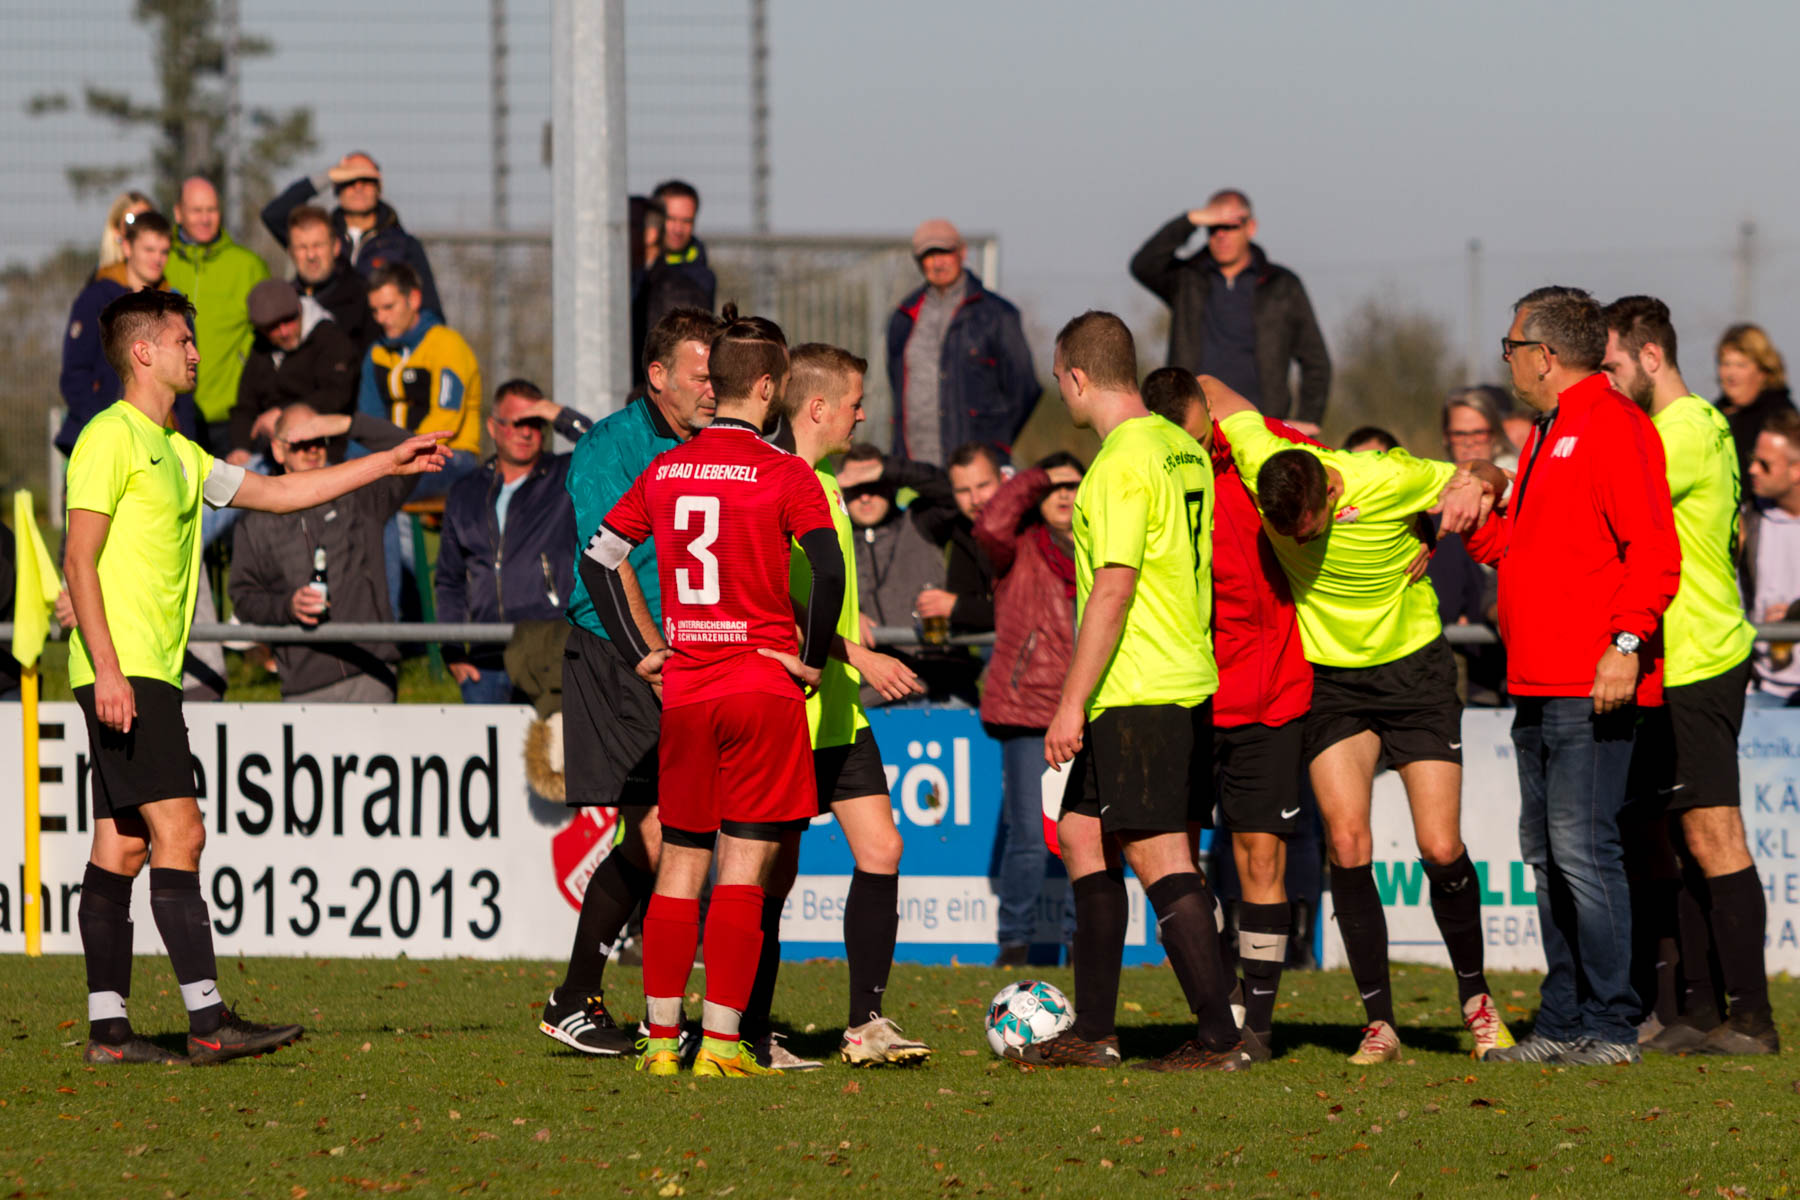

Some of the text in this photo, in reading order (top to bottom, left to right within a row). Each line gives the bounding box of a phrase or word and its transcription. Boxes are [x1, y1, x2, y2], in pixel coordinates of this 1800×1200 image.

[656, 463, 758, 482] SV BAD LIEBENZELL
[674, 496, 720, 605] 3
[678, 620, 748, 630] UNTERREICHENBACH
[678, 633, 748, 642] SCHWARZENBERG
[212, 866, 502, 941] 913-2013
[947, 892, 987, 922] ein
